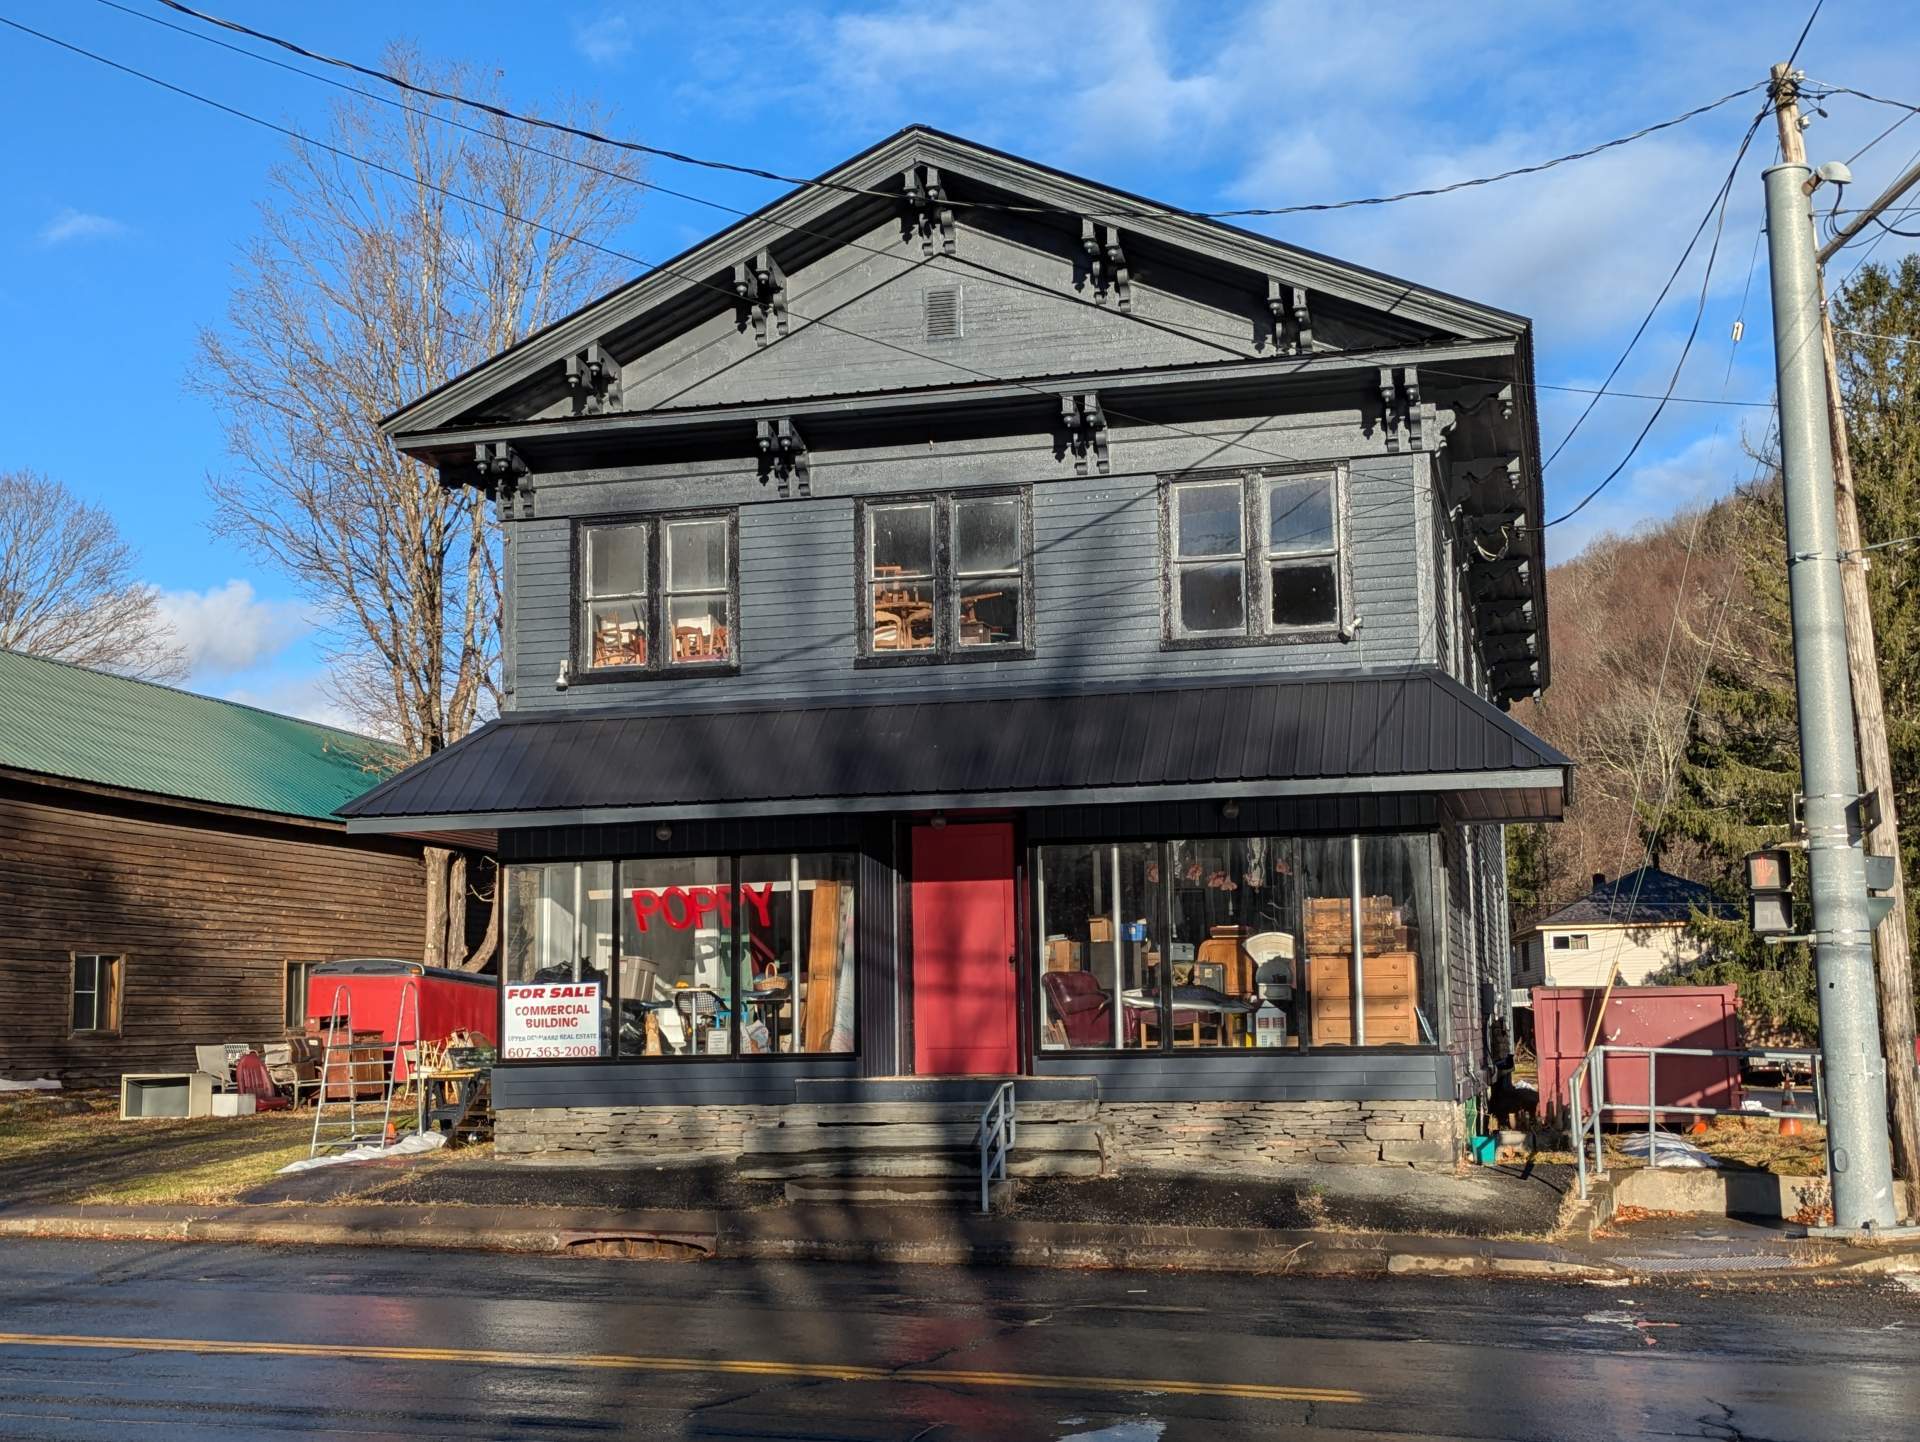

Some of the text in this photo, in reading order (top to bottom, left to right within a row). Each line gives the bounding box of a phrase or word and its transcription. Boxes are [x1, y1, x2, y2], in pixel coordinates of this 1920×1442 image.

[632, 882, 773, 933] POPPY
[508, 986, 597, 999] FOR SALE
[515, 1004, 590, 1016] COMMERCIAL
[526, 1017, 578, 1029] BUILDING
[508, 1045, 597, 1058] 607-363-2008
